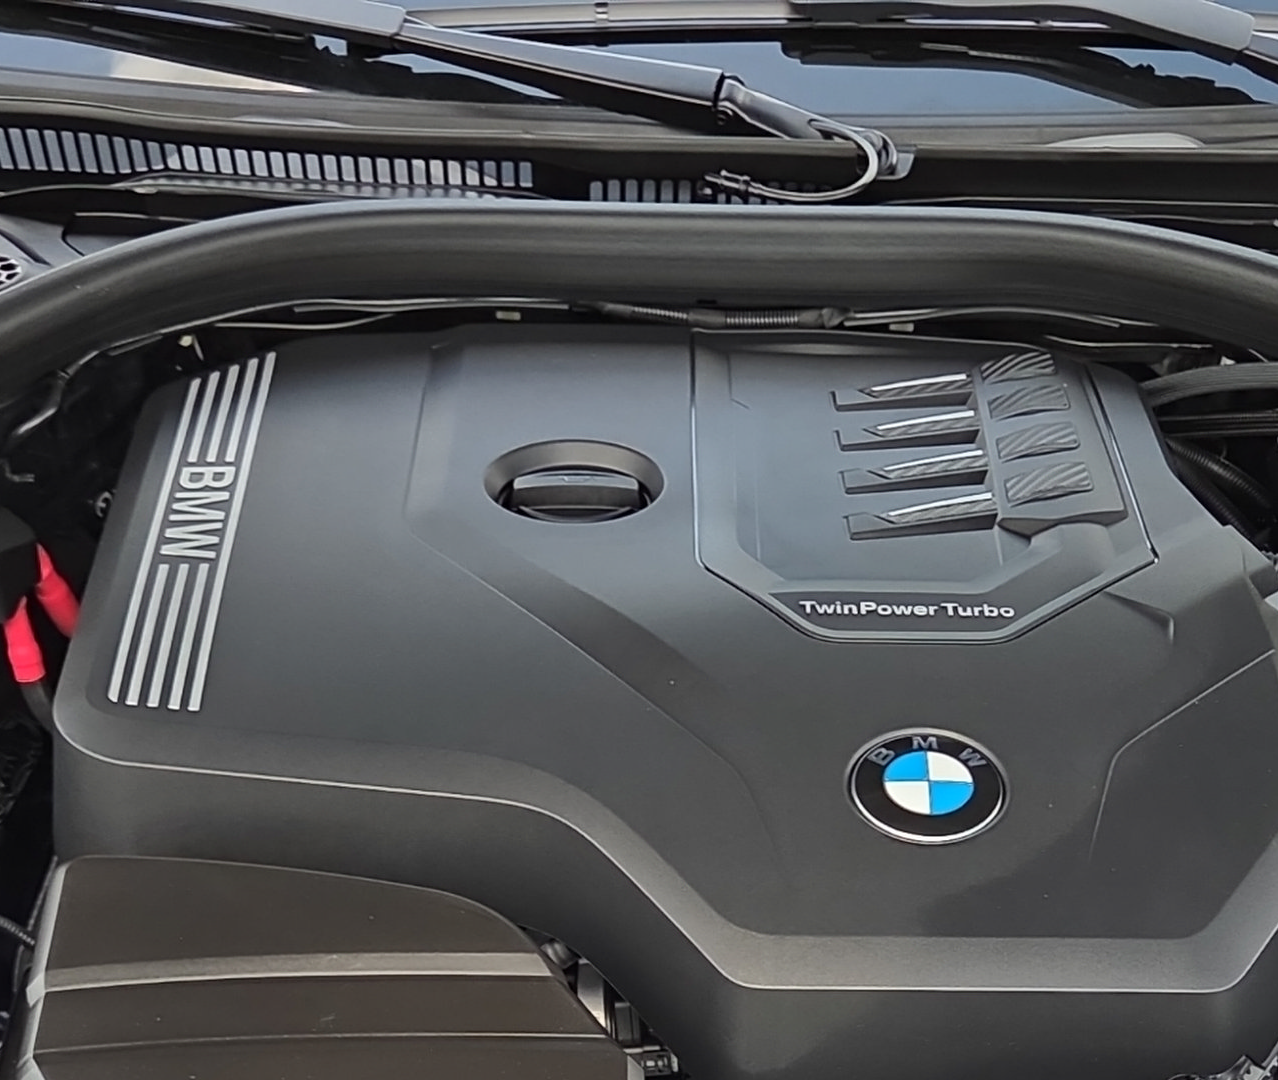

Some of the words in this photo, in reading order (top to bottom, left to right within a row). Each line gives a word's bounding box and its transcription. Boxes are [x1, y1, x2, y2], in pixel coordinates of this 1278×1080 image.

[160, 466, 236, 559] BMW
[799, 600, 939, 617] TwinPower
[941, 602, 1016, 618] Turbo
[867, 735, 987, 767] BMW
